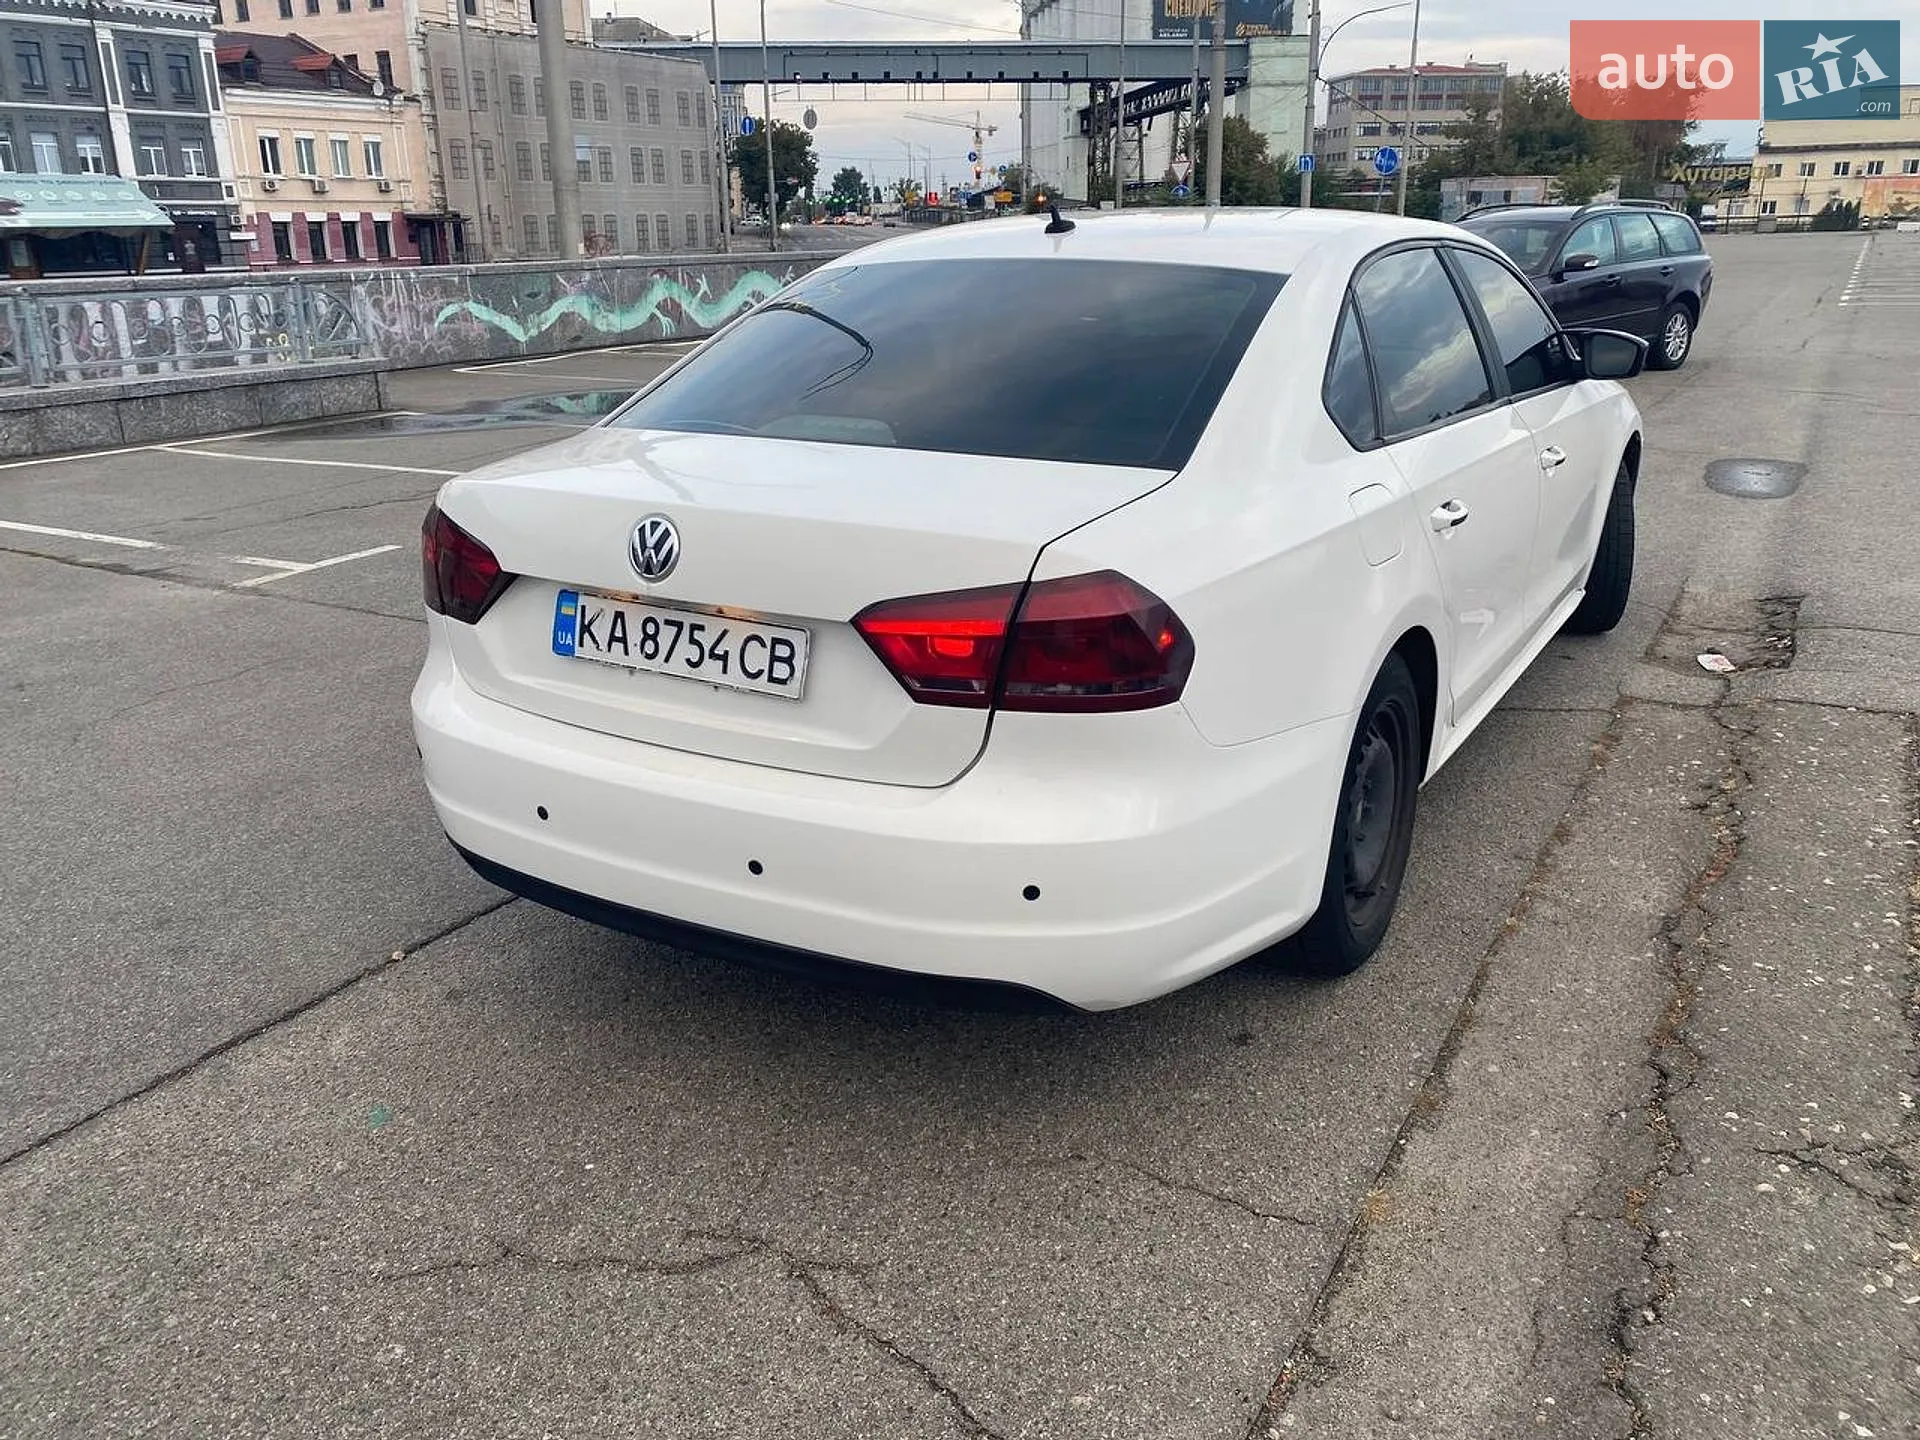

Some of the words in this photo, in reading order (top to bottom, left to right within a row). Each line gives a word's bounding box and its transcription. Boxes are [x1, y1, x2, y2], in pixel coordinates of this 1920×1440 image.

[558, 632, 573, 646] UA
[578, 604, 630, 657] KA
[640, 616, 730, 675] 8754
[739, 634, 796, 685] CB
